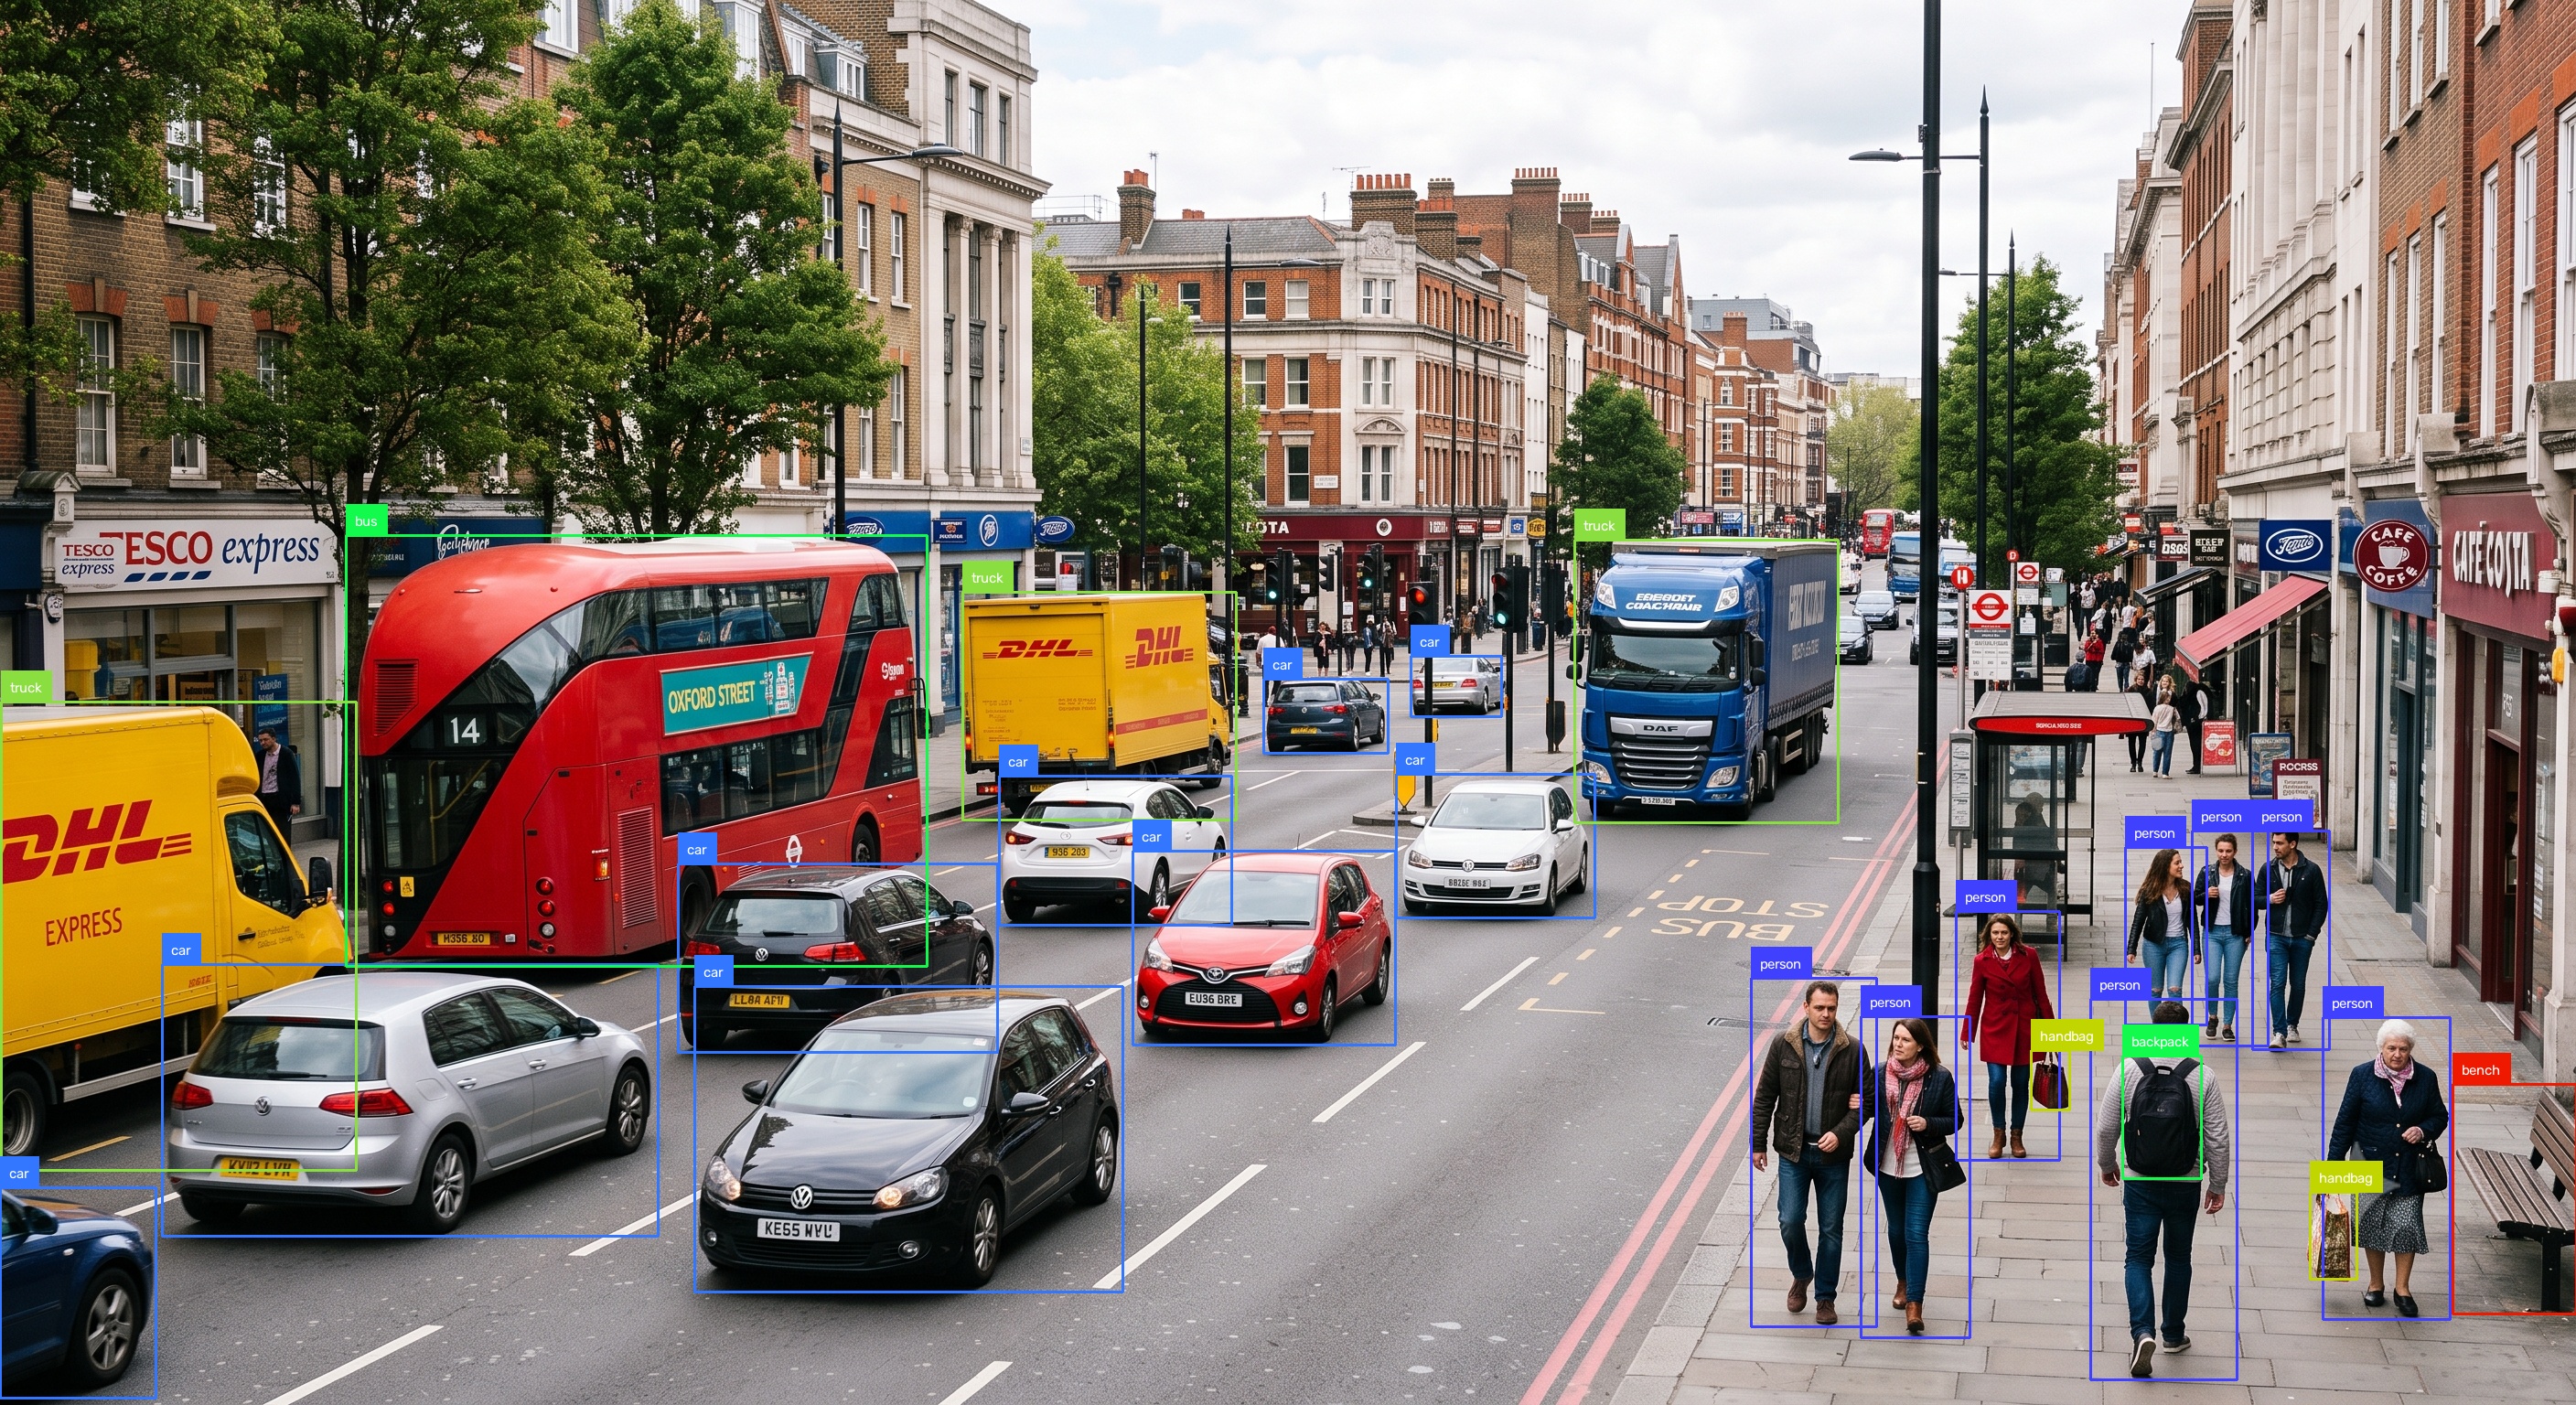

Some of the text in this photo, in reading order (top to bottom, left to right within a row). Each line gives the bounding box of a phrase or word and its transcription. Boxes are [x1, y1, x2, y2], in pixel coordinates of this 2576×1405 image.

[2371, 527, 2415, 543] CAFE
[62, 544, 114, 557] TESCO
[221, 532, 320, 574] express
[61, 562, 115, 578] express
[998, 639, 1079, 659] DHL
[1135, 626, 1184, 668] DHL
[668, 681, 756, 714] OXFORD STREET
[451, 716, 480, 745] 14
[1643, 724, 1679, 733] DAF
[3, 799, 165, 885] DHL
[1657, 895, 1830, 918] STOP
[46, 906, 123, 947] EXPRESS
[1650, 917, 1796, 942] BUS
[1189, 993, 1237, 1004] EU36 BRE
